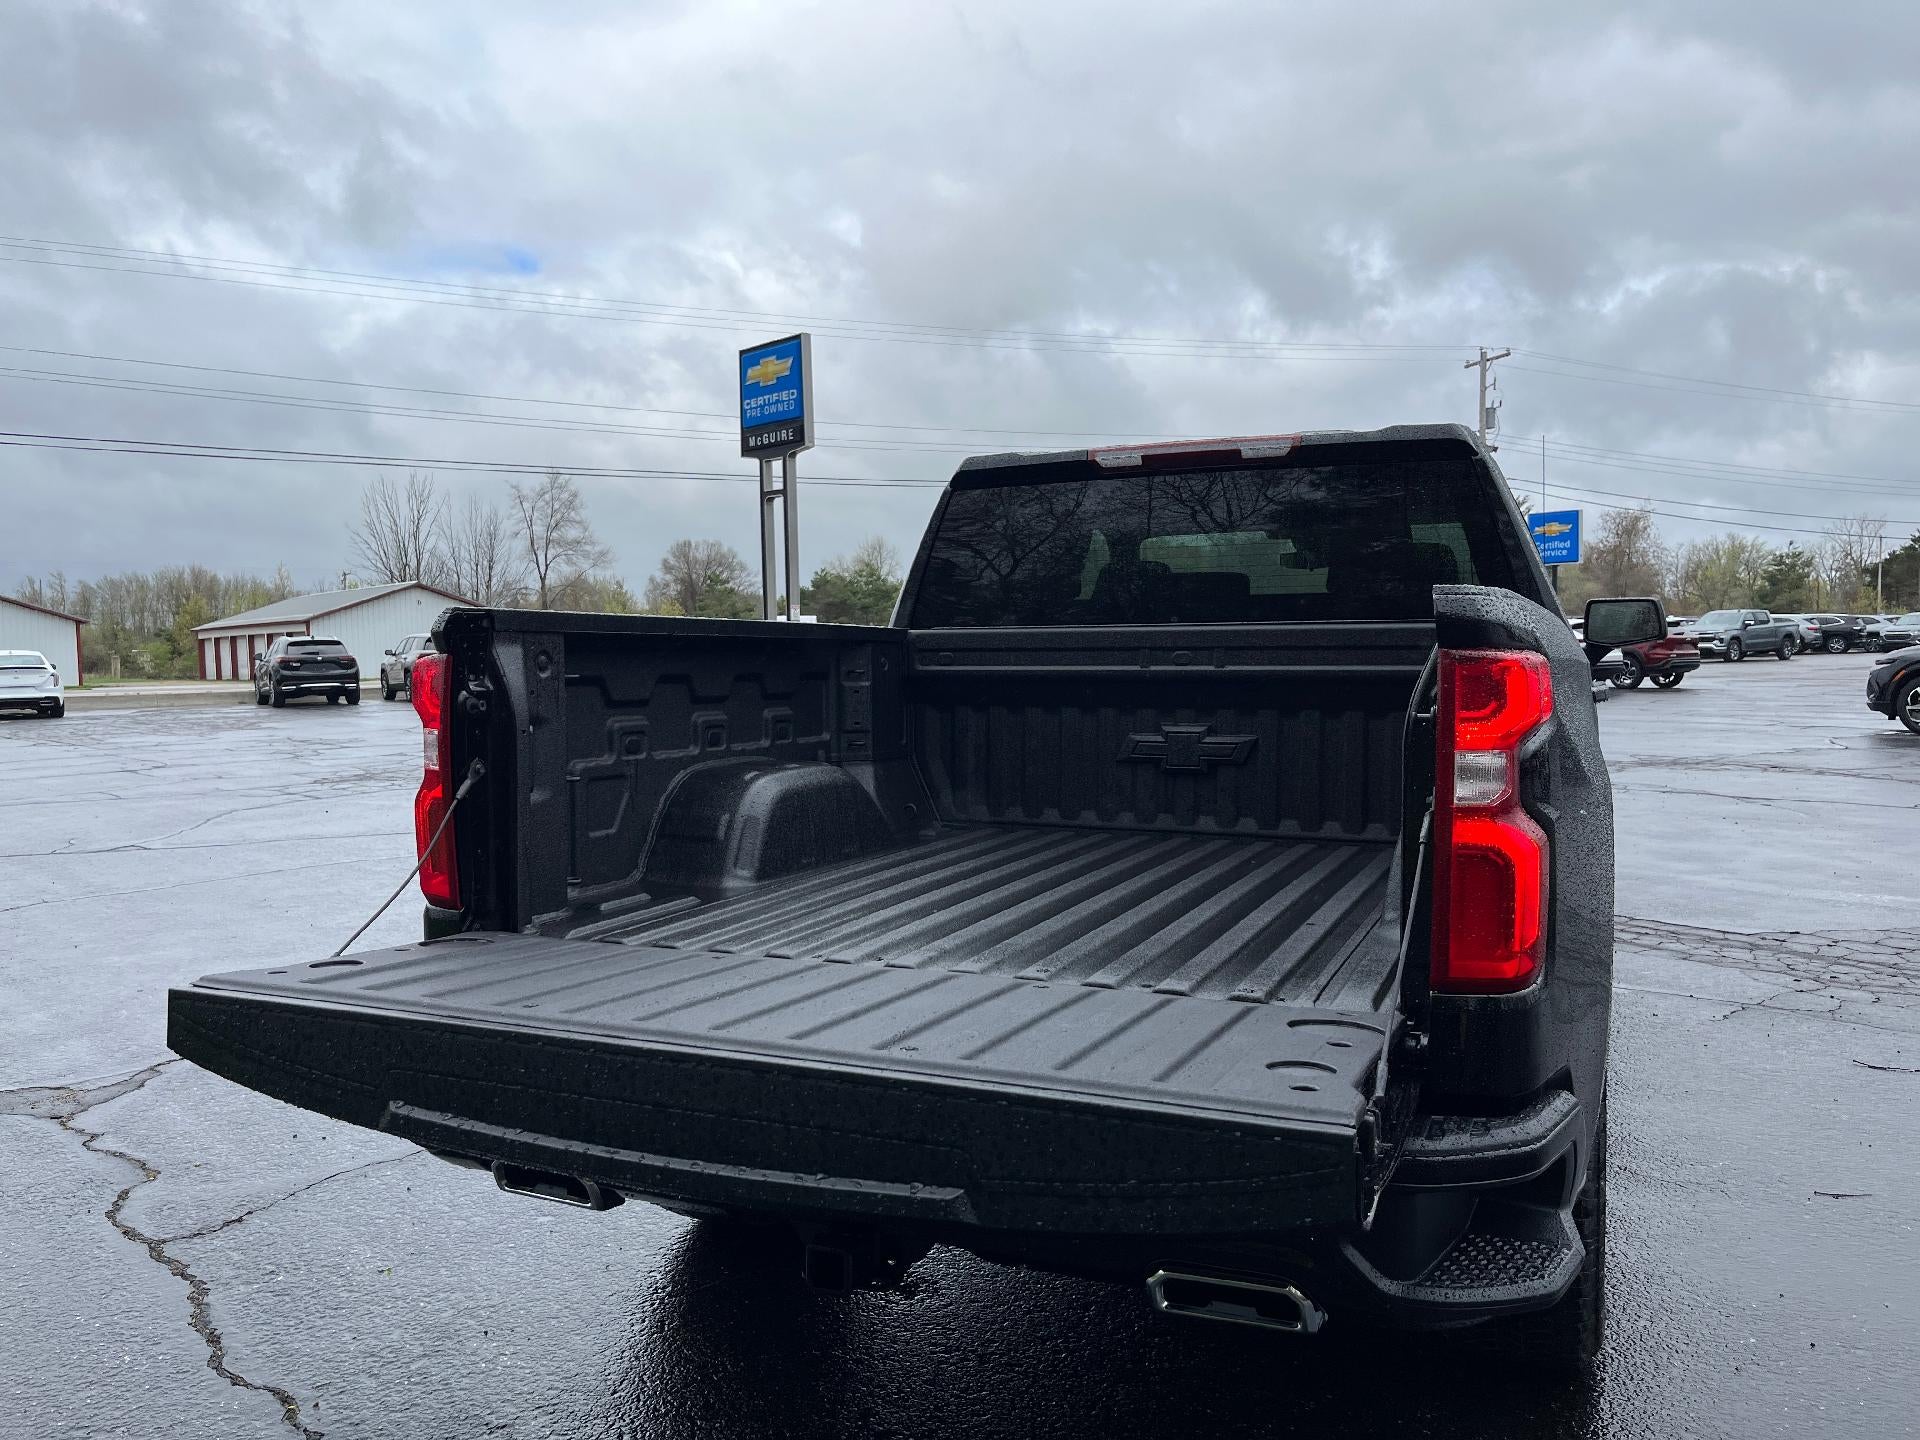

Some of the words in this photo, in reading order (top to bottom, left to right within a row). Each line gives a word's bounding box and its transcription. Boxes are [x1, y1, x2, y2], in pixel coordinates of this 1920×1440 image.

[744, 389, 797, 409] CERTIFIED
[746, 400, 795, 418] PRE-OWNED
[749, 428, 794, 447] McGUIRE
[1536, 540, 1570, 550] Certified
